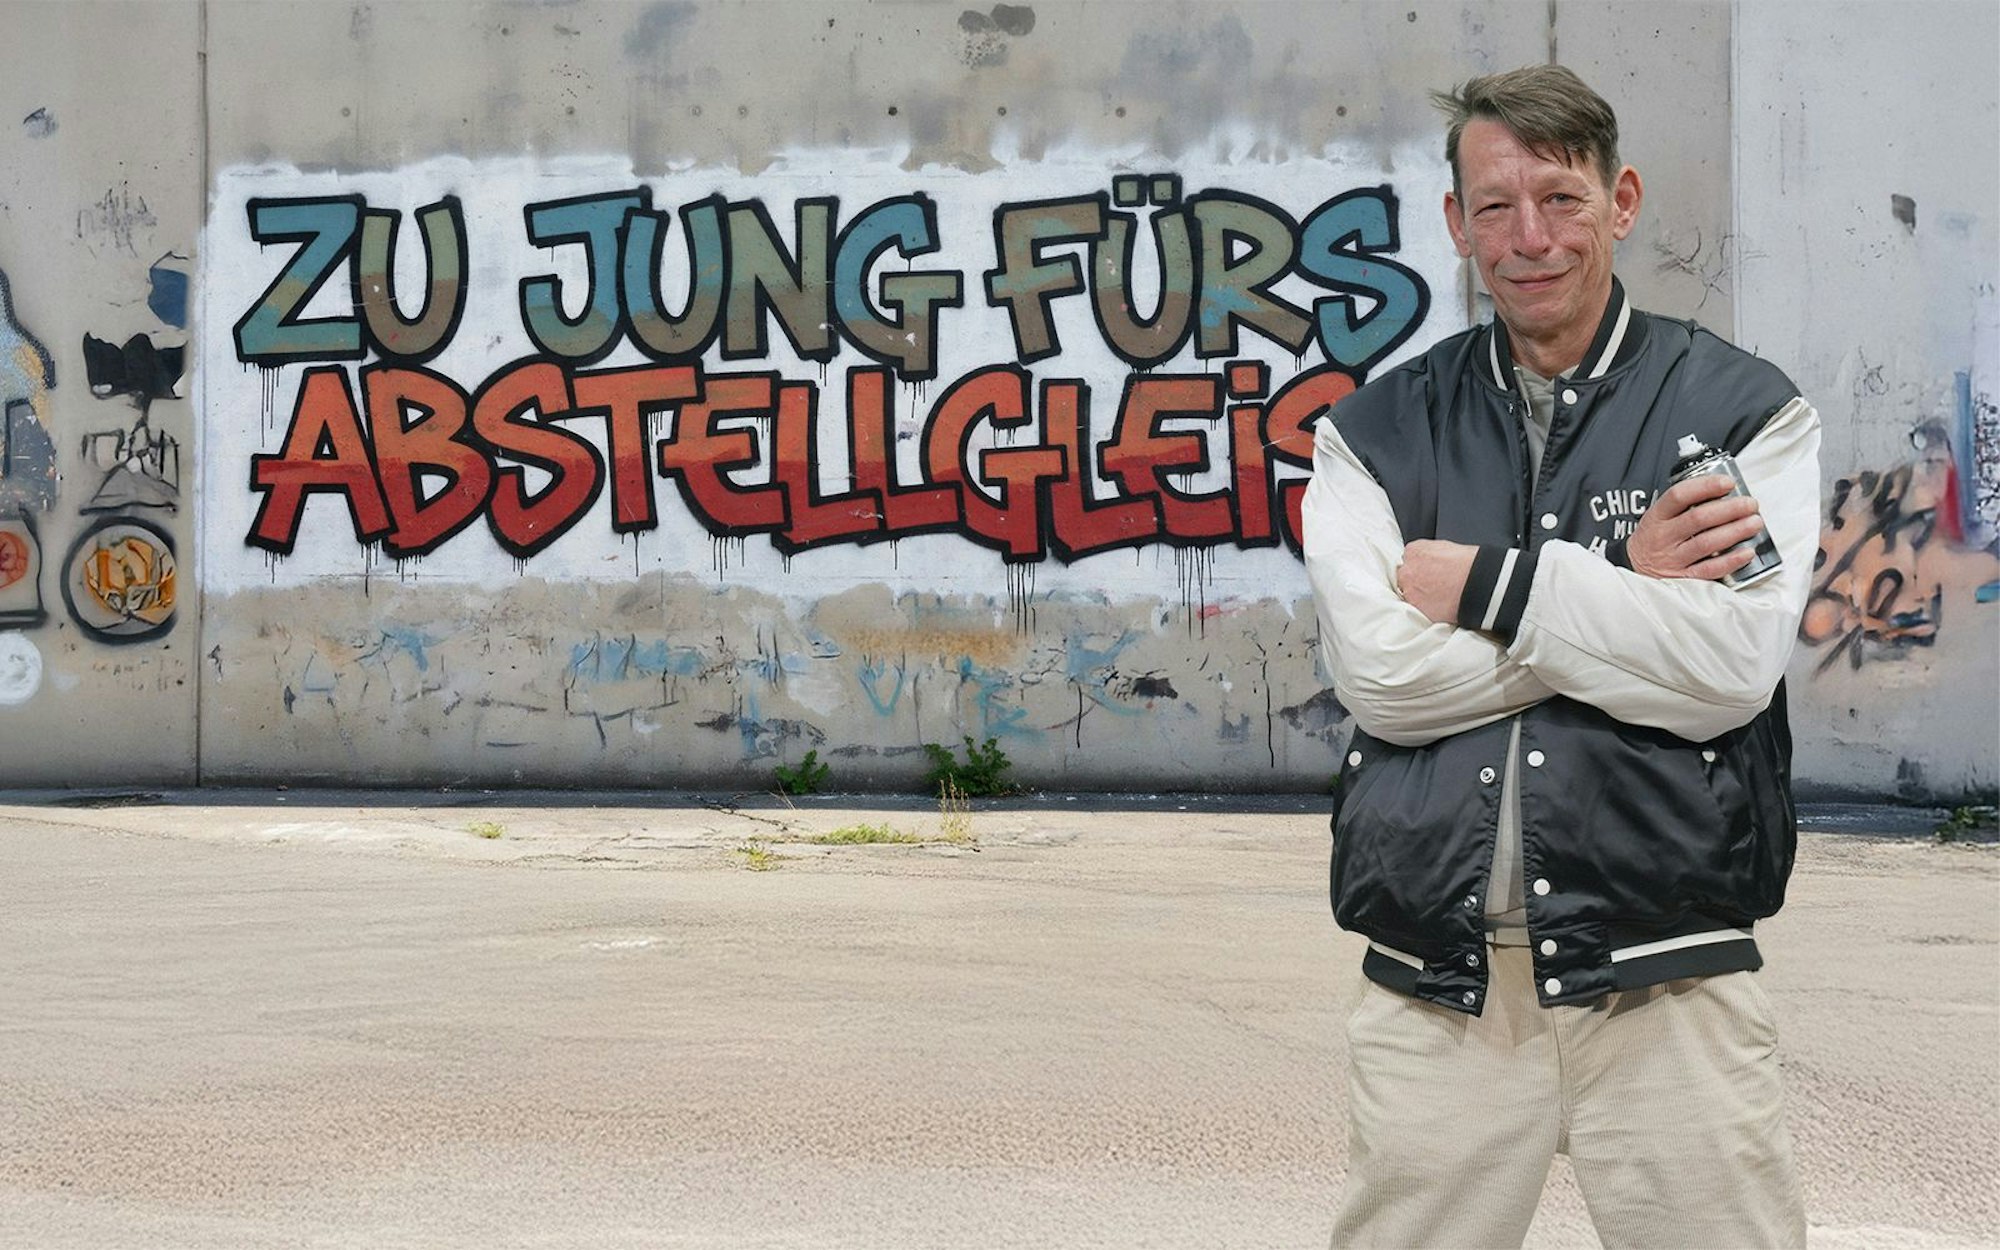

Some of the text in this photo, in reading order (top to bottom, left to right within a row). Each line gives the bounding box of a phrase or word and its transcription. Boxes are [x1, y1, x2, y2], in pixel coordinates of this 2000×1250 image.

[233, 174, 1431, 380] ZU JUNG FÜRS
[1590, 489, 1659, 522] CHIC
